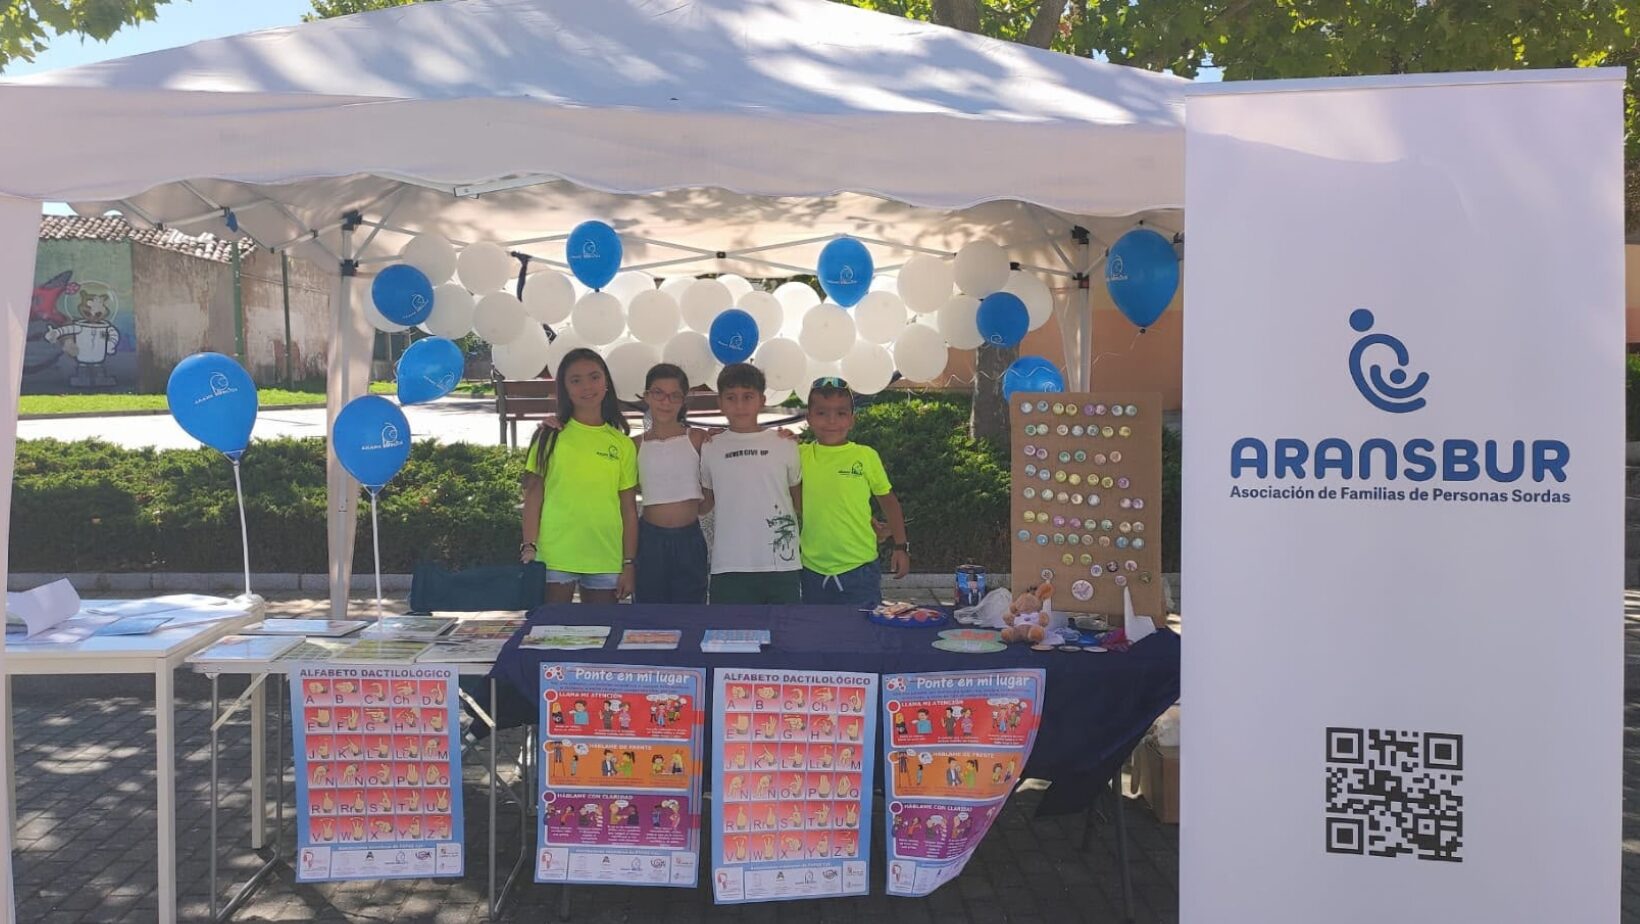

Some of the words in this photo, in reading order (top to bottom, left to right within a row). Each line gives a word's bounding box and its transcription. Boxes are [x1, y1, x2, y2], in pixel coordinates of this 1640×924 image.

[1230, 438, 1570, 482] ARANSBUR
[1230, 486, 1314, 500] Asociación
[1318, 487, 1337, 500] de
[1341, 487, 1405, 501] Familias
[1410, 487, 1429, 502] de
[1433, 489, 1508, 503] Personas
[1512, 490, 1571, 503] Sordas
[300, 669, 357, 677] ALFABETO
[576, 668, 613, 681] Ponte
[618, 671, 636, 682] en
[642, 672, 653, 683] mi
[656, 670, 690, 686] lugar
[724, 673, 779, 681] ALFABETO
[917, 677, 954, 689] Ponte
[959, 676, 975, 687] en
[979, 677, 993, 686] mi
[997, 675, 1029, 687] lugar
[306, 696, 314, 704] A
[336, 695, 343, 703] B
[365, 695, 373, 704] C
[393, 696, 410, 705] Ch
[423, 697, 431, 705] D
[728, 700, 735, 709] A
[756, 701, 763, 709] B
[784, 701, 793, 710] C
[812, 702, 828, 711] Ch
[841, 704, 849, 712] D
[308, 723, 315, 731] E
[338, 723, 344, 731] F
[366, 723, 375, 731] G
[727, 730, 733, 738] E
[755, 730, 762, 738] F
[784, 730, 792, 740] G
[811, 731, 819, 740] H
[339, 750, 347, 758] K
[438, 751, 448, 759] M
[754, 760, 761, 768] K
[782, 760, 788, 768] L
[851, 761, 861, 769] M
[369, 777, 378, 785] O
[398, 777, 405, 785] P
[741, 791, 748, 799] N
[781, 790, 790, 798] O
[809, 790, 816, 798] P
[850, 790, 859, 798] Q
[370, 804, 377, 812] S
[399, 804, 406, 812] T
[427, 804, 435, 812] U
[726, 822, 734, 830] R
[781, 819, 788, 828] S
[808, 819, 814, 827] T
[836, 818, 844, 827] U
[313, 833, 321, 842] V
[342, 832, 352, 840] W
[371, 832, 378, 840] X
[400, 831, 406, 839] Y
[428, 830, 434, 838] Z
[727, 853, 734, 861] V
[754, 851, 763, 860] W
[781, 850, 788, 859] X
[808, 848, 814, 857] Y
[835, 847, 841, 856] Z
